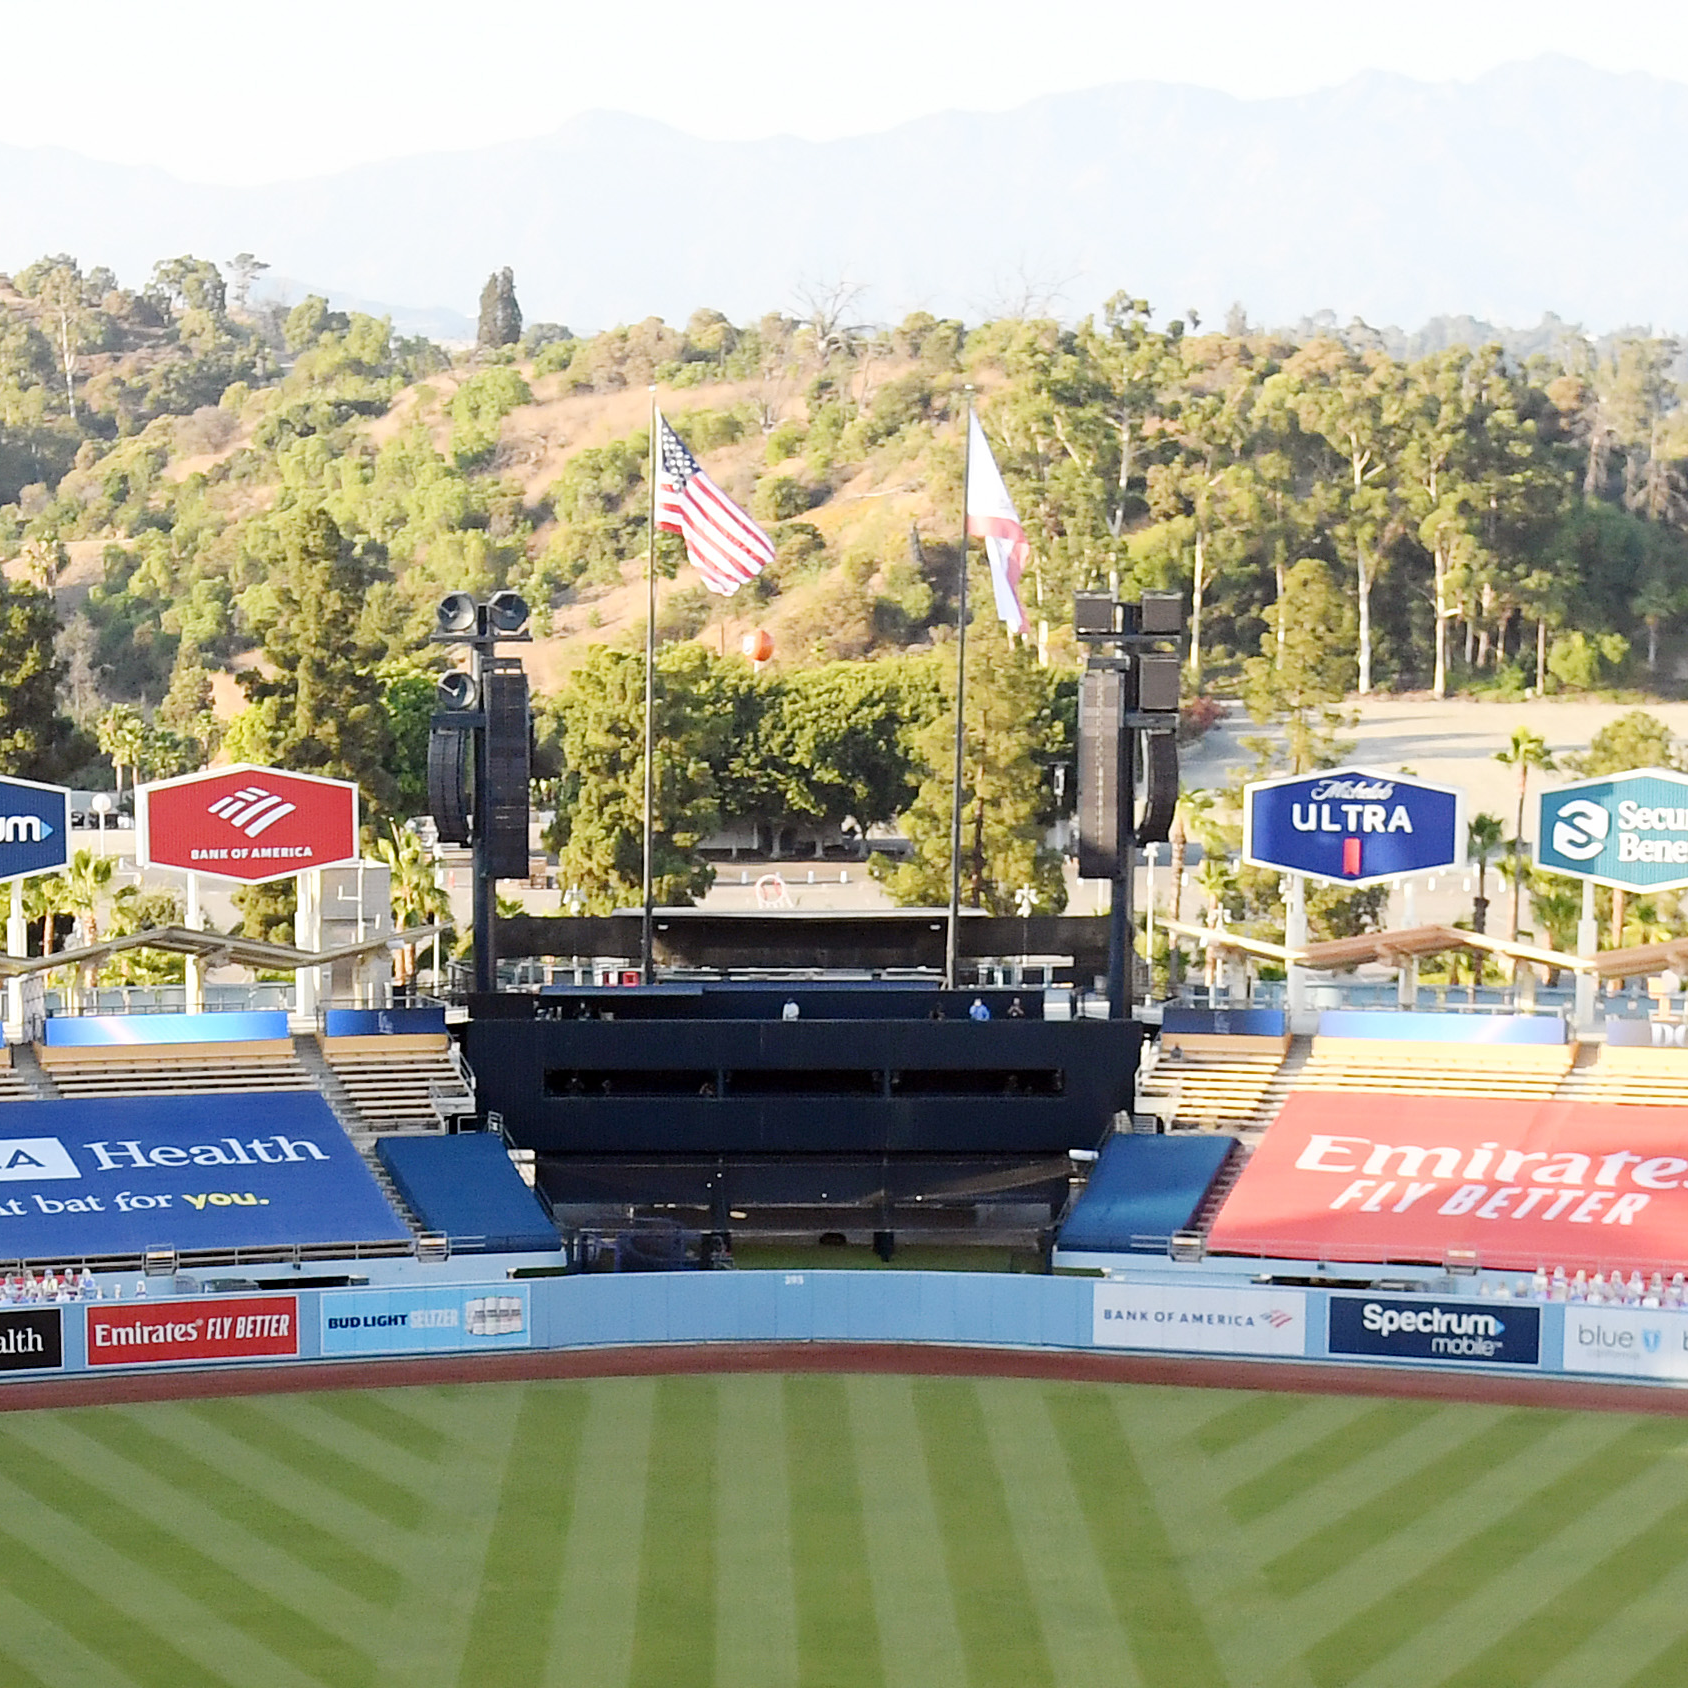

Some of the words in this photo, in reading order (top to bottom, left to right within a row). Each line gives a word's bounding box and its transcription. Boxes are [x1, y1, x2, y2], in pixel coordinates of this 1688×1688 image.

[1292, 803, 1413, 833] ULTRA
[190, 849, 228, 860] BANK
[231, 848, 249, 859] OF
[251, 847, 313, 859] AMERICA
[83, 1135, 331, 1171] Health
[39, 1193, 106, 1215] bat
[114, 1190, 174, 1212] for
[181, 1191, 270, 1212] you.
[1330, 1178, 1437, 1213] FLY
[1439, 1183, 1652, 1226] BETTER
[94, 1320, 198, 1348] Emirates
[206, 1317, 232, 1340] FLY
[235, 1313, 290, 1338] BETTER
[328, 1316, 361, 1329] BUD
[363, 1314, 408, 1328] LIGHT
[1104, 1308, 1149, 1322] BANK
[1154, 1311, 1176, 1325] OF
[1177, 1312, 1257, 1328] AMERICA
[1362, 1303, 1497, 1339] Spectrum
[1431, 1335, 1495, 1357] mobile
[1578, 1324, 1634, 1349] blue
